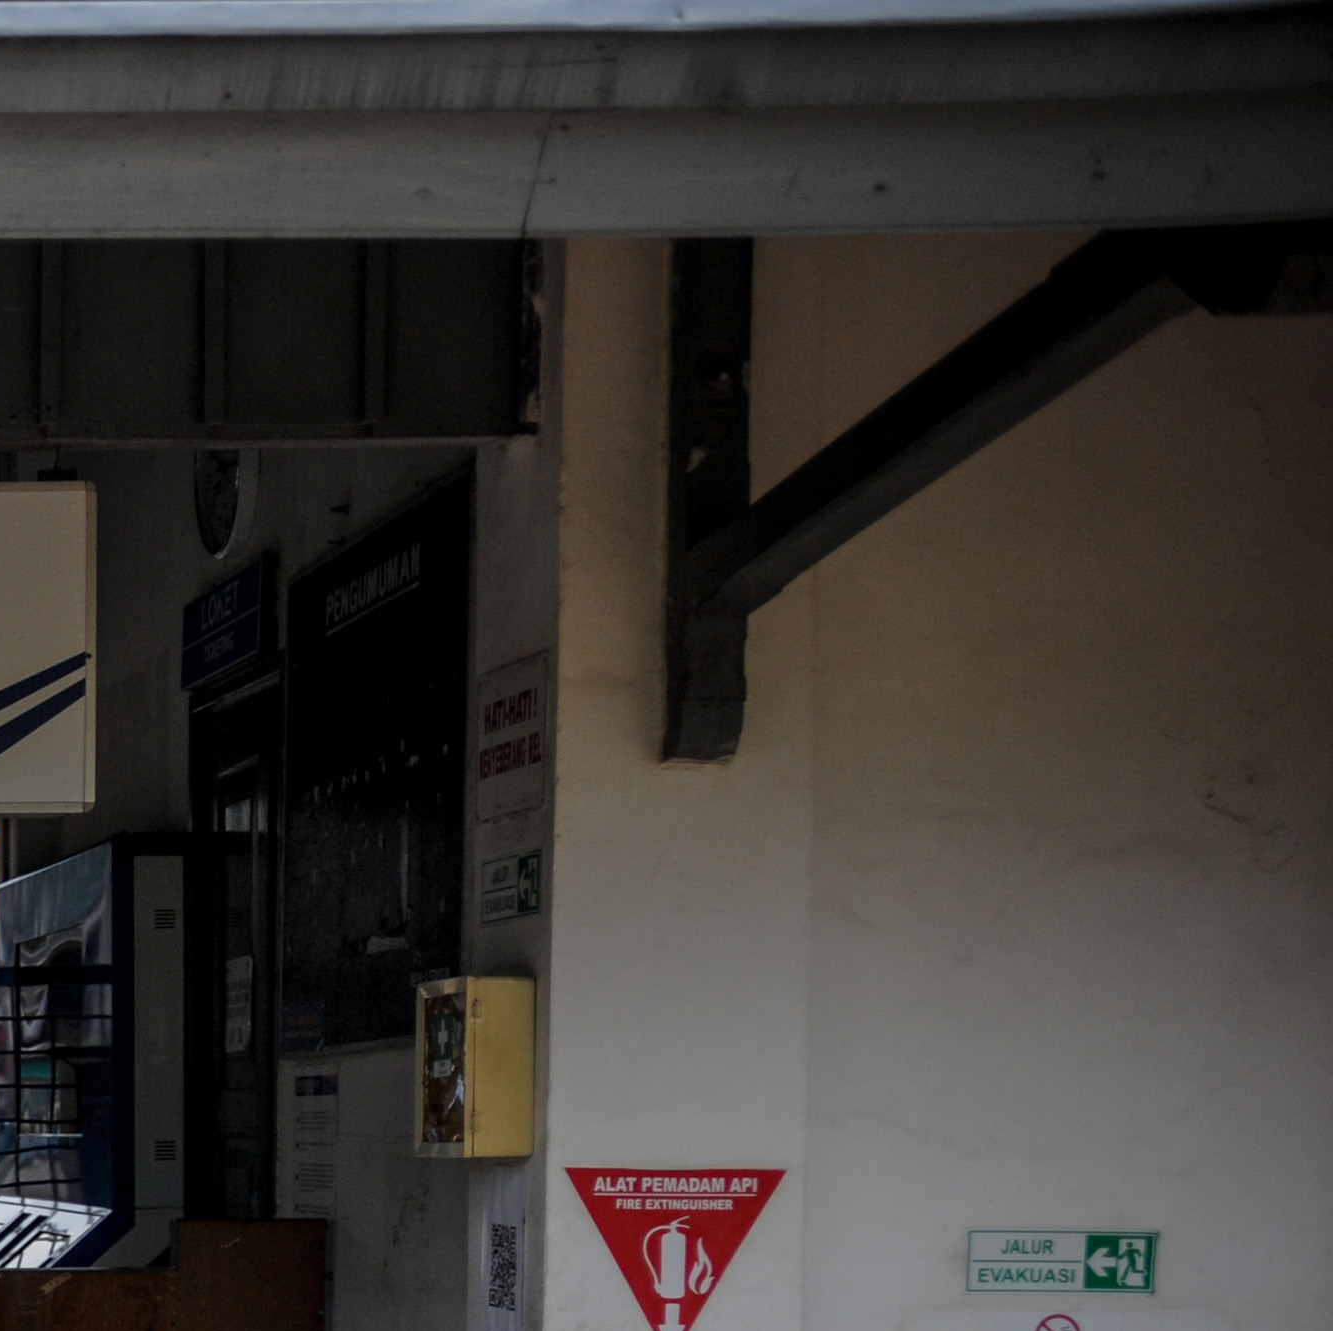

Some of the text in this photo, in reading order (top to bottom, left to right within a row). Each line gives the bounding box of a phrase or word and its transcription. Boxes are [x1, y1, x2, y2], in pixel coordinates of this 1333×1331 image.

[325, 541, 420, 627] PENGUMUMAN
[200, 578, 240, 631] LOKET
[594, 1176, 759, 1193] ALAT PEMADAM API
[615, 1198, 734, 1211] FIRE EXTINGUISHER
[1000, 1239, 1054, 1254] JALUR
[978, 1268, 1076, 1284] EVAKUASI
